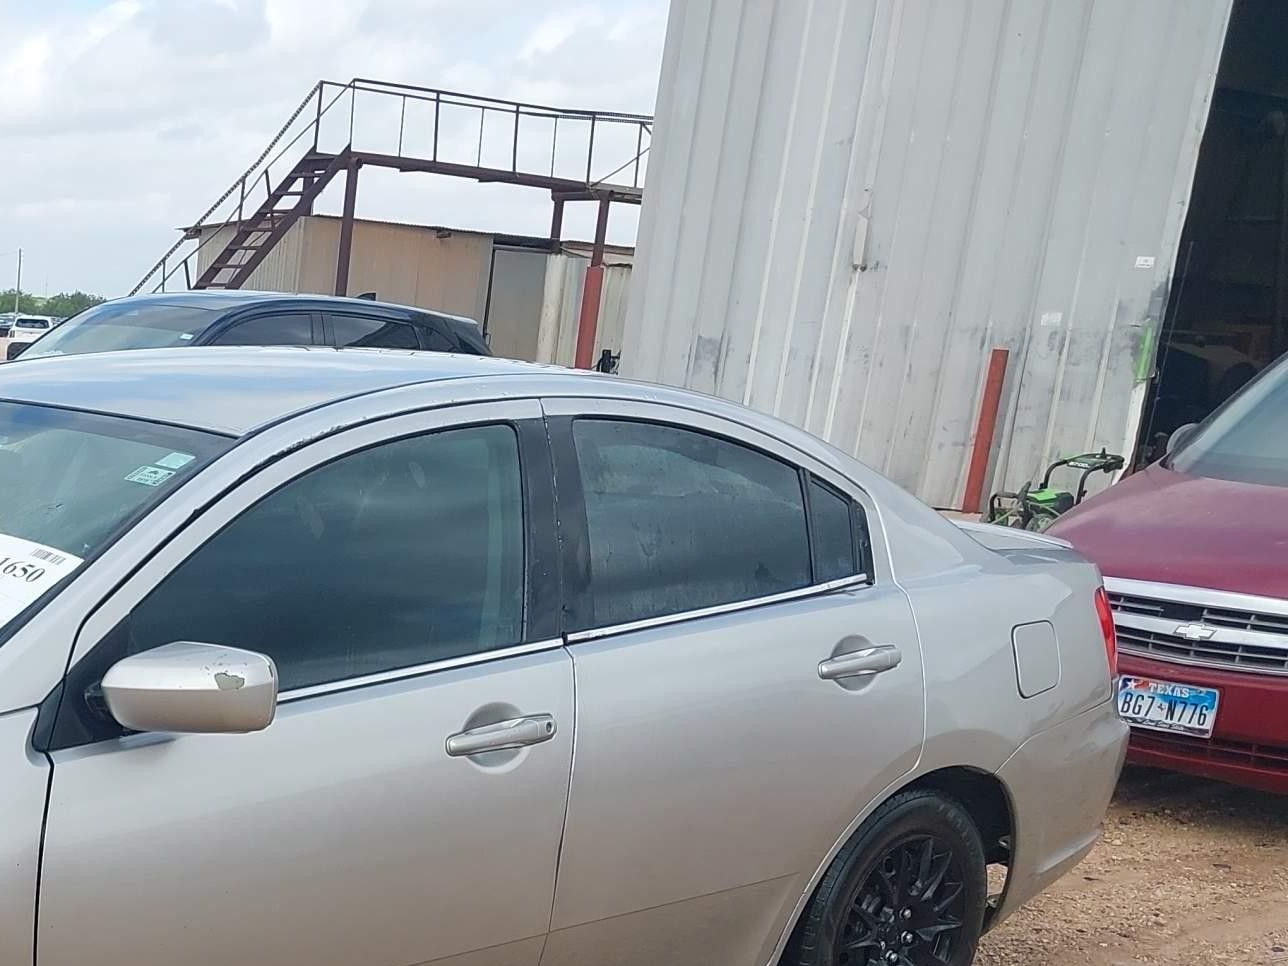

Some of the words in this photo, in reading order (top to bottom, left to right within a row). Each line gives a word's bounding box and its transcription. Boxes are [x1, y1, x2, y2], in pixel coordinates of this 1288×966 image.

[1148, 682, 1191, 698] TEXAS
[1121, 692, 1156, 717] BG7
[1165, 701, 1209, 726] N776
